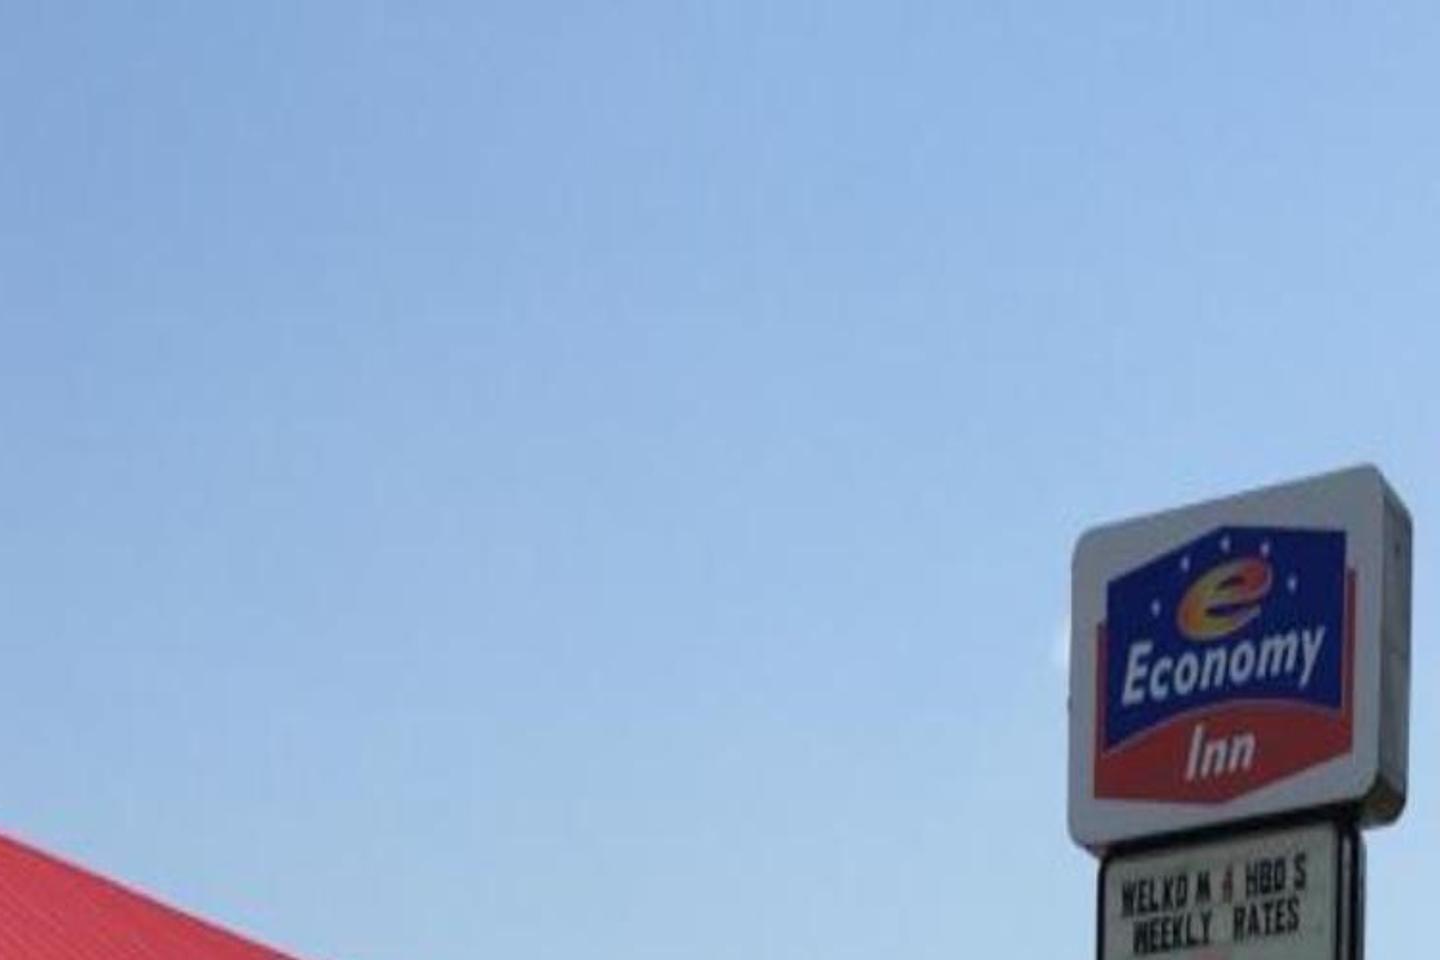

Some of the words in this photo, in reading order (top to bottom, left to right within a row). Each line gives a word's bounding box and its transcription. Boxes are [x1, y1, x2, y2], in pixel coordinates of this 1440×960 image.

[1121, 624, 1326, 706] Economy
[1185, 722, 1257, 783] Inn
[1134, 910, 1212, 955] WEEKLY
[1233, 898, 1300, 941] RATES
